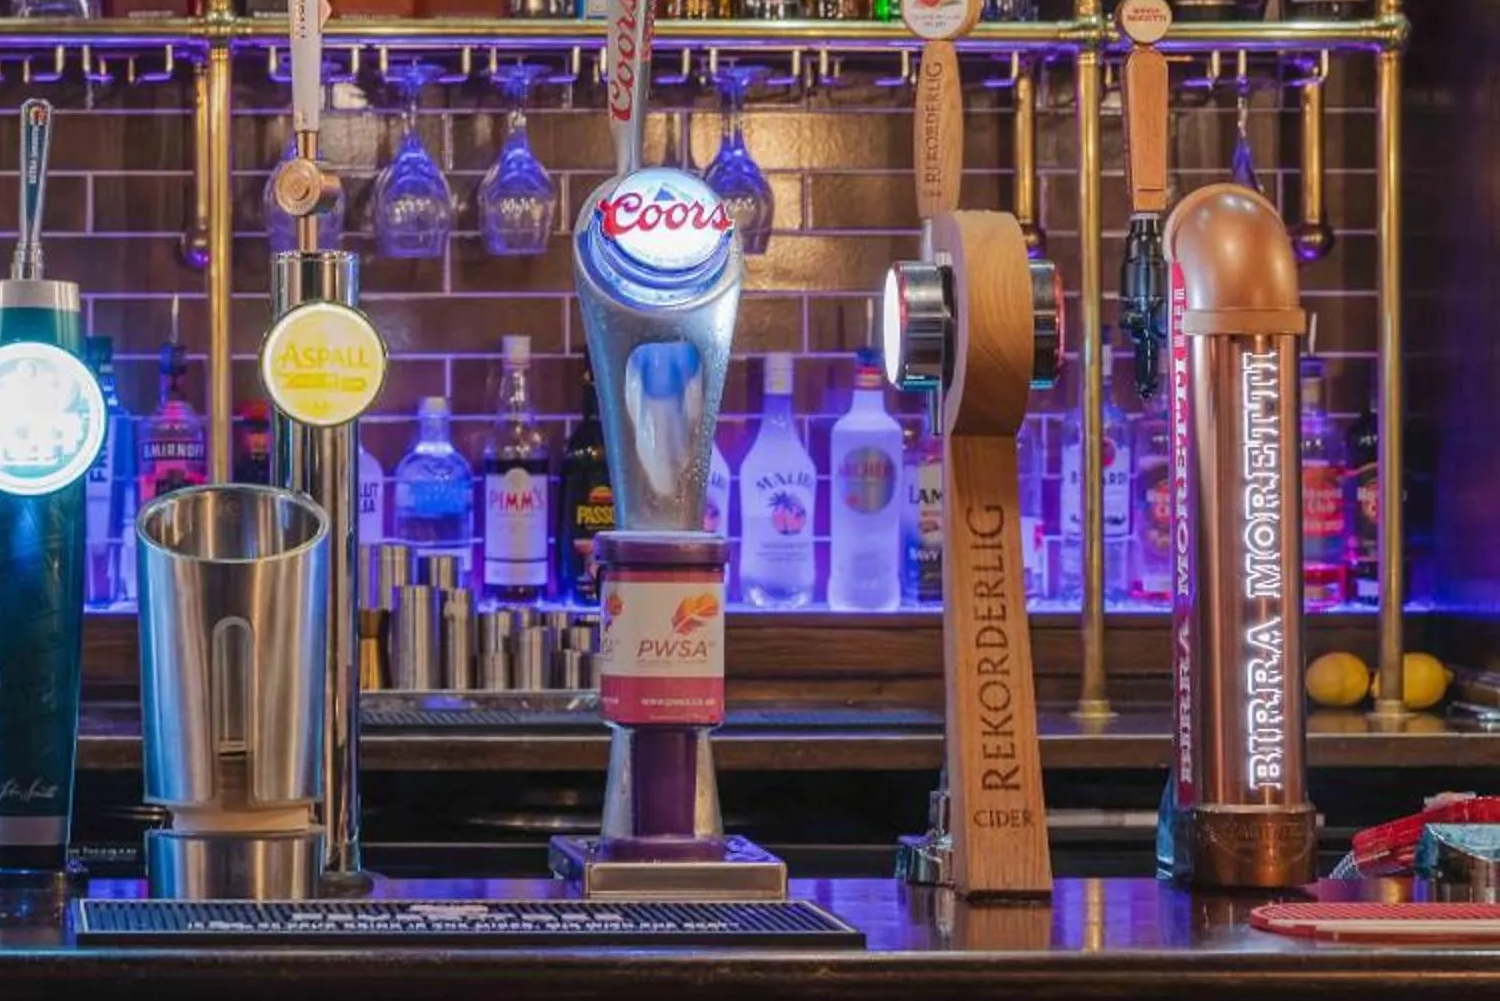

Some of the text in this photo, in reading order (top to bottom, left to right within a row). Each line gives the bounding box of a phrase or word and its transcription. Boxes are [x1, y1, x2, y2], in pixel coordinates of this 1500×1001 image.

[595, 192, 734, 238] Coors
[278, 340, 370, 370] ASPALL
[909, 485, 943, 504] LAM
[1174, 357, 1190, 597] MORETTI
[1241, 350, 1283, 791] BIRRA MORETTI
[637, 639, 708, 659] PWSA
[966, 504, 1021, 793] REKORDERLIG
[972, 808, 1035, 828] CIDER
